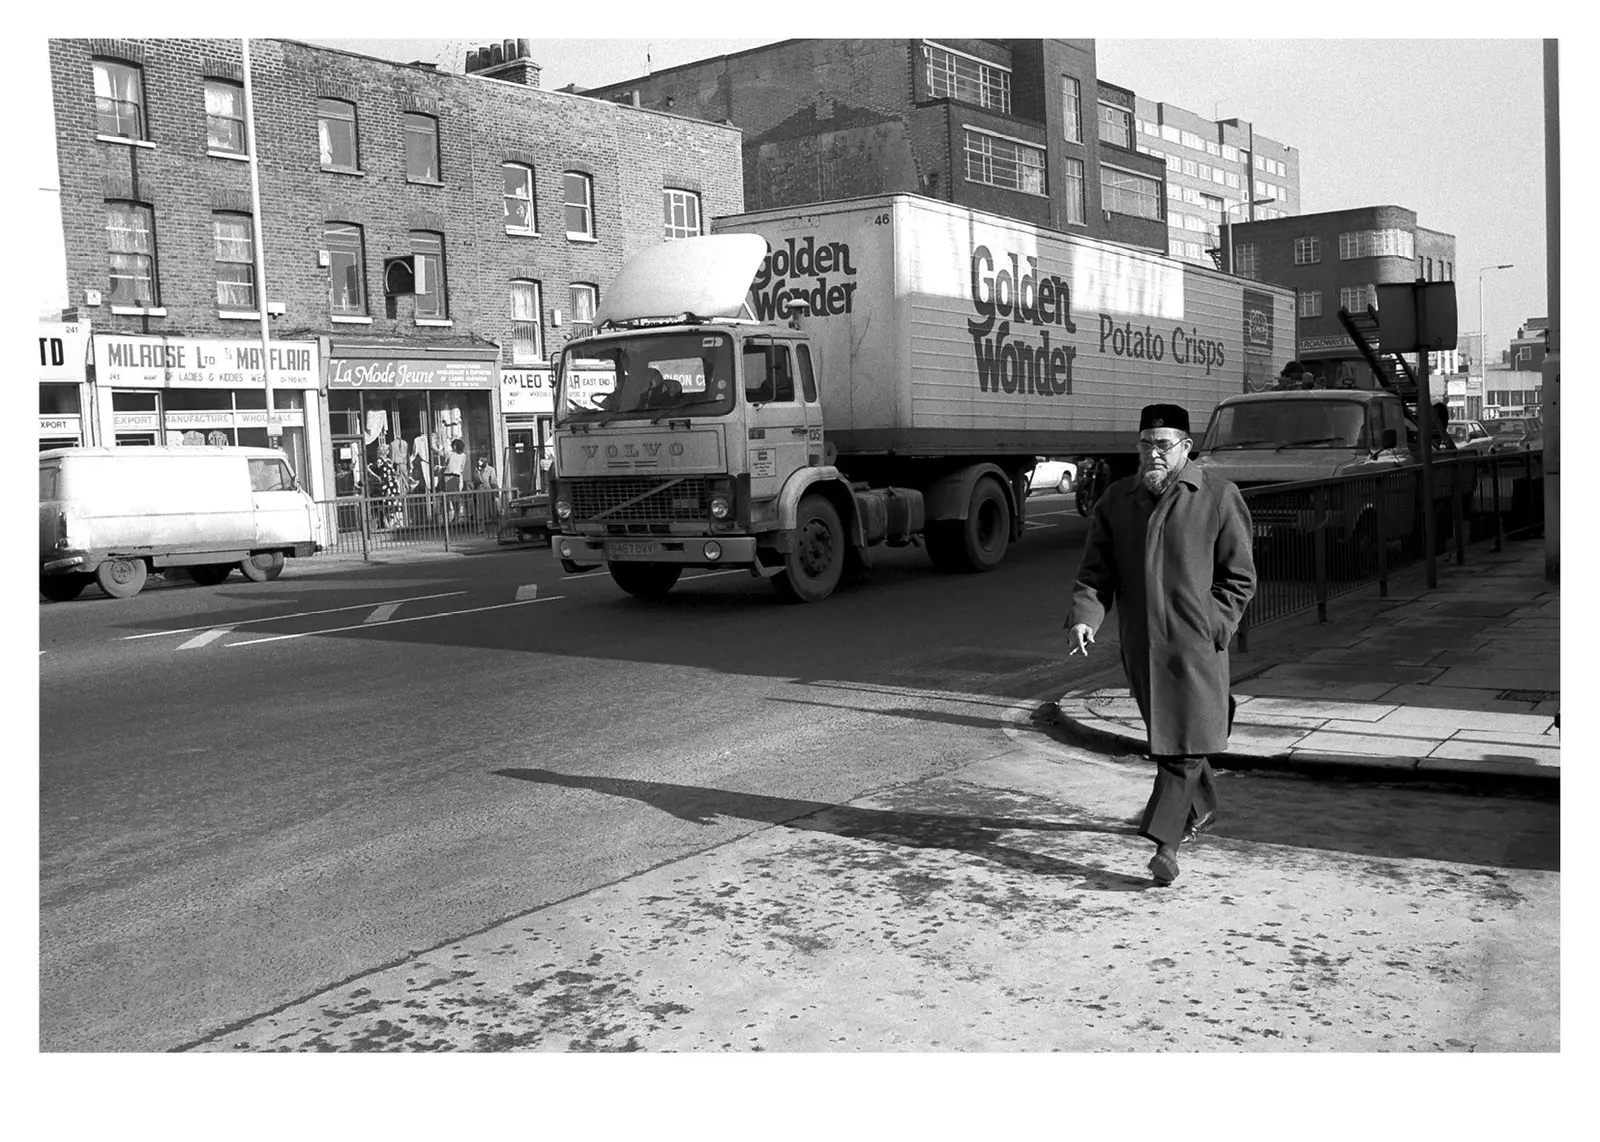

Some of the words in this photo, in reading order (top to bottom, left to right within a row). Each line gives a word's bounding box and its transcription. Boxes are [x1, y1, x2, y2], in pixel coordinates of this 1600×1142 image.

[875, 214, 890, 226] 46
[752, 277, 857, 322] Wonder
[968, 245, 1076, 337] Golden
[108, 343, 186, 368] MILROSE
[237, 347, 311, 371] MAYFLAIR
[1099, 313, 1165, 361] Potato
[1172, 327, 1225, 375] Crisps
[968, 321, 1076, 396] Wonder
[165, 371, 174, 381] OF
[179, 372, 203, 382] LADIES
[208, 373, 214, 382] &
[219, 373, 244, 382] KIDDIES
[250, 374, 267, 383] WEA
[334, 359, 352, 383] La
[352, 362, 396, 386] Mode
[396, 364, 434, 387] Jeune
[520, 374, 542, 388] LEO
[548, 374, 580, 389] SAR
[583, 378, 596, 386] EAST
[114, 415, 153, 424] EXPORT
[164, 414, 229, 424] MANUFACTURE
[242, 413, 293, 423] WHOLALE
[582, 442, 684, 459] VOLVO
